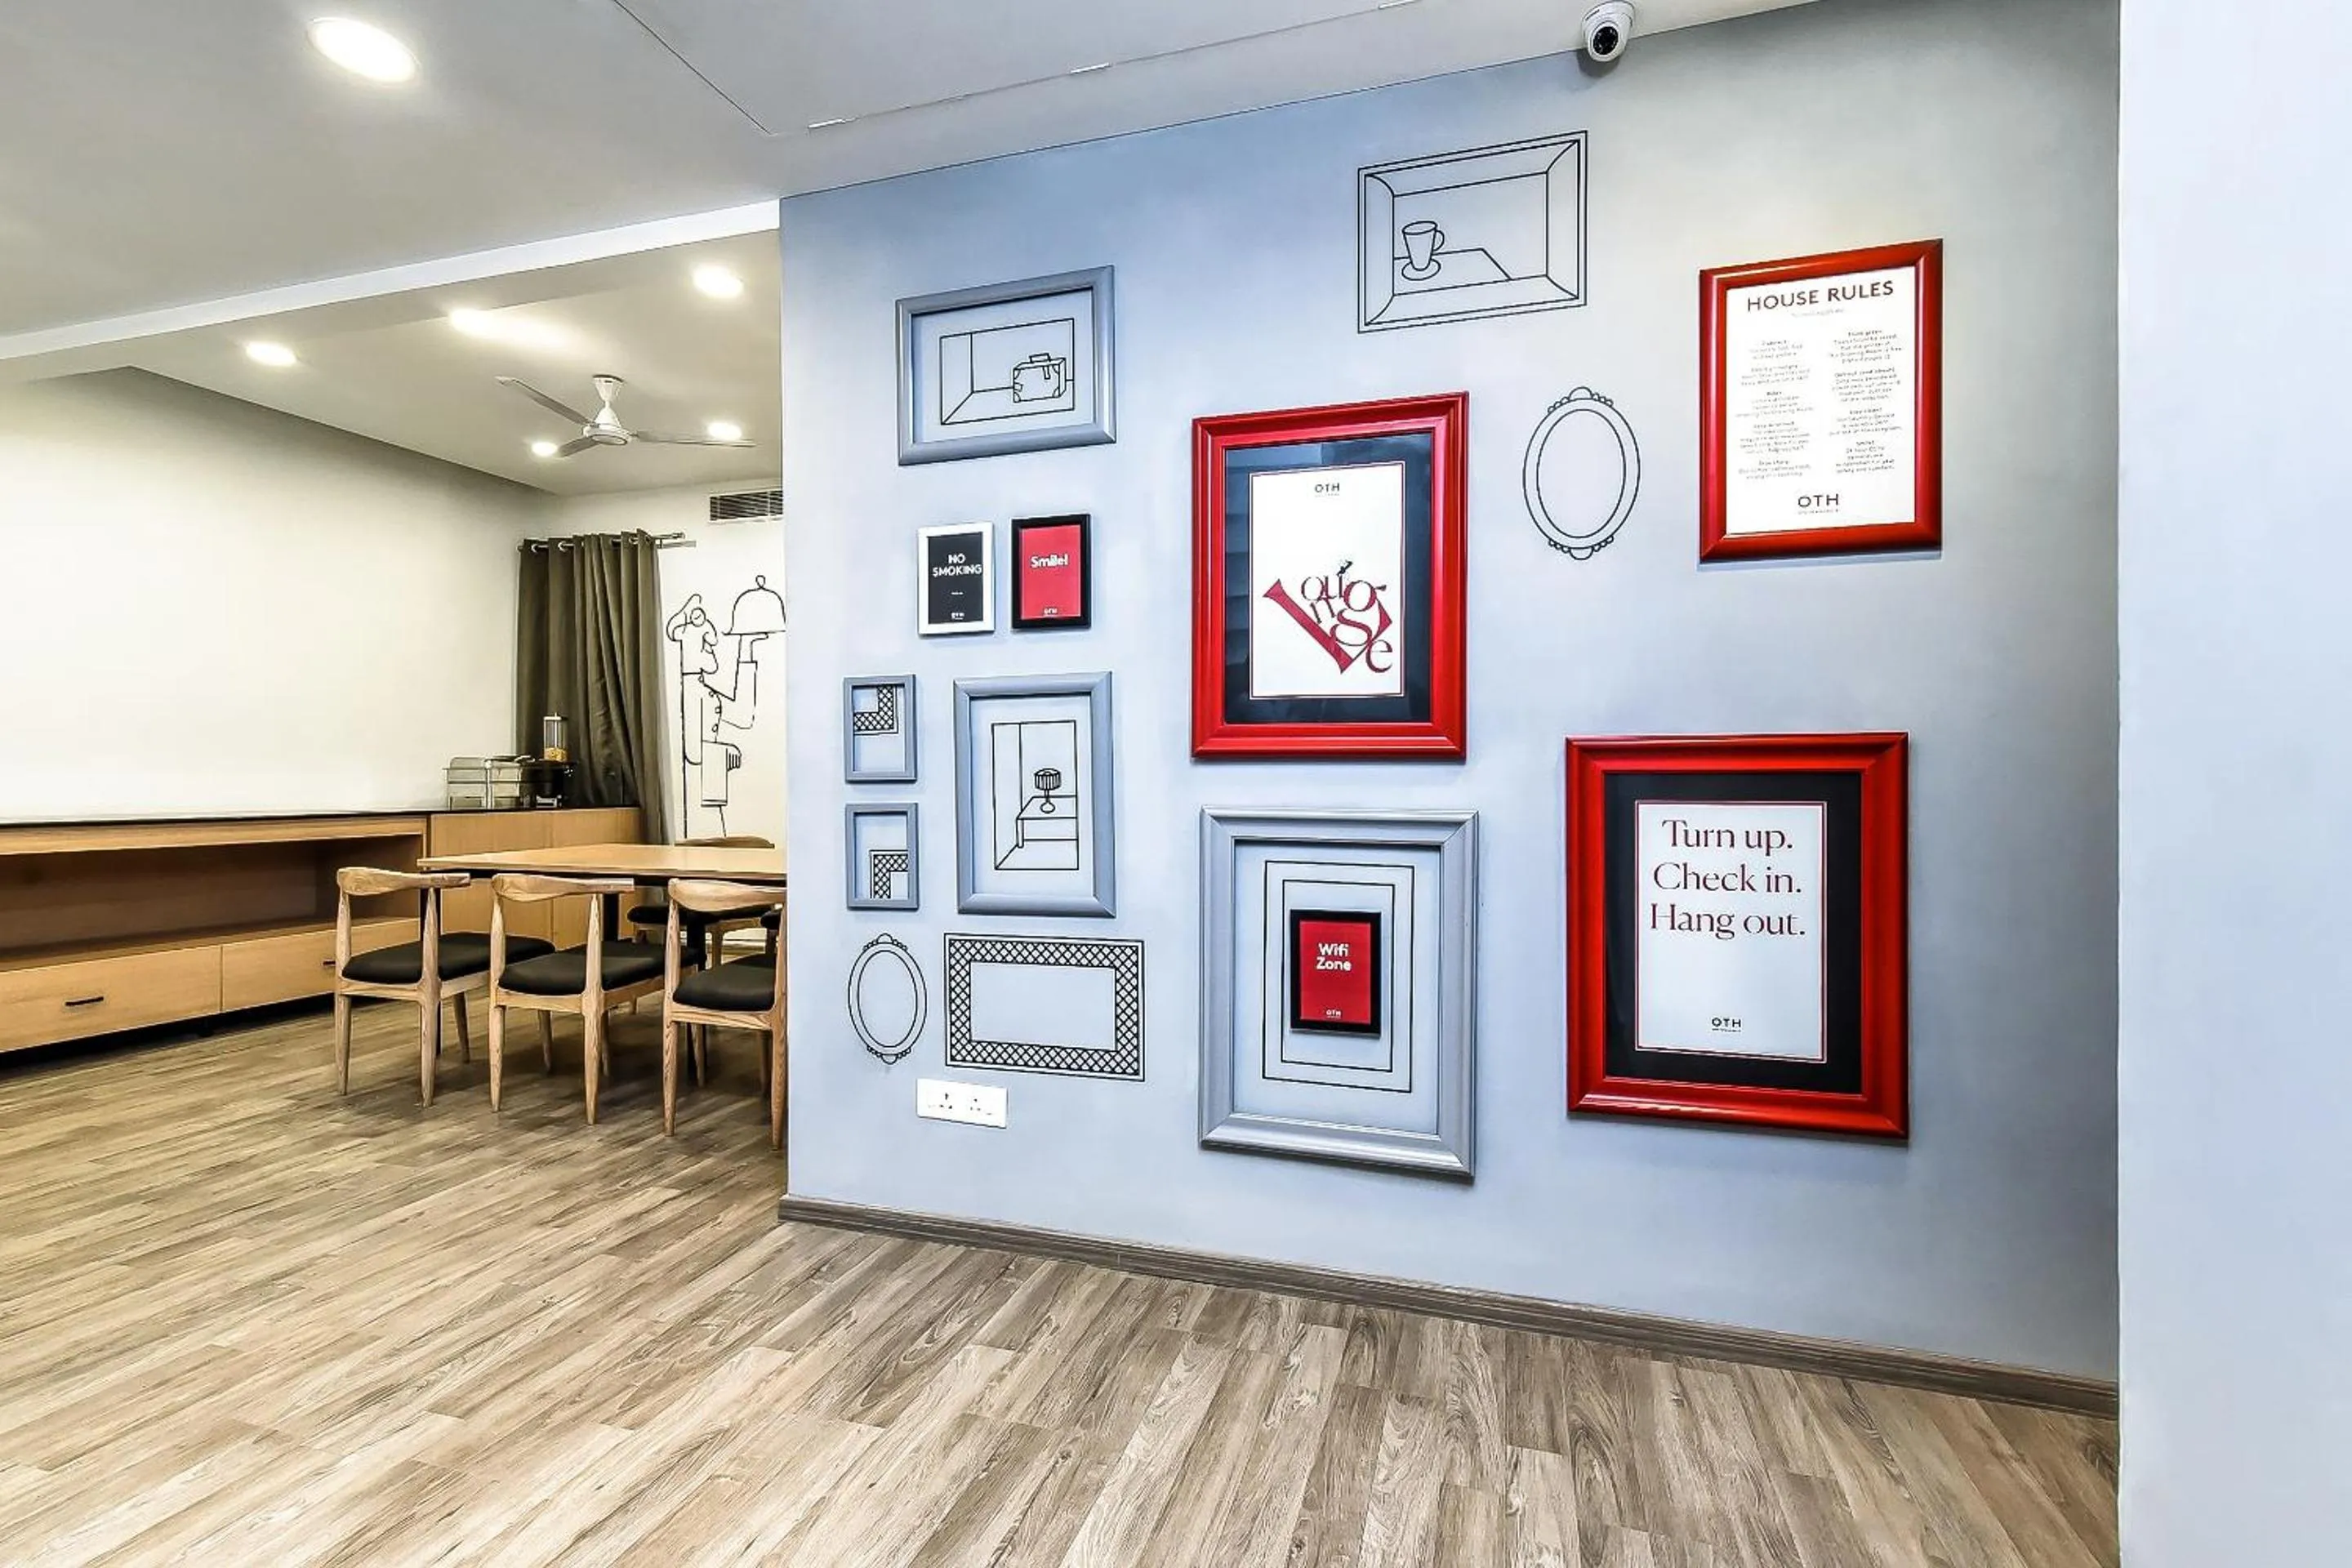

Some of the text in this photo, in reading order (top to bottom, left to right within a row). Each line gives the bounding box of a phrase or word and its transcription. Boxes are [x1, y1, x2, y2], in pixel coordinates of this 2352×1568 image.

[1748, 289, 1819, 312] HOUSE
[1828, 280, 1894, 301] RULES
[1315, 483, 1340, 492] OTH
[1797, 493, 1839, 508] OTH
[948, 553, 966, 564] NO
[933, 564, 982, 577] SMOKING
[1661, 819, 1793, 857] Turn up.
[1653, 862, 1802, 893] Check in.
[1650, 902, 1806, 940] Hang out.
[1318, 942, 1349, 956] Wifi
[1316, 956, 1352, 971] Zone
[1712, 1018, 1741, 1027] OTH
